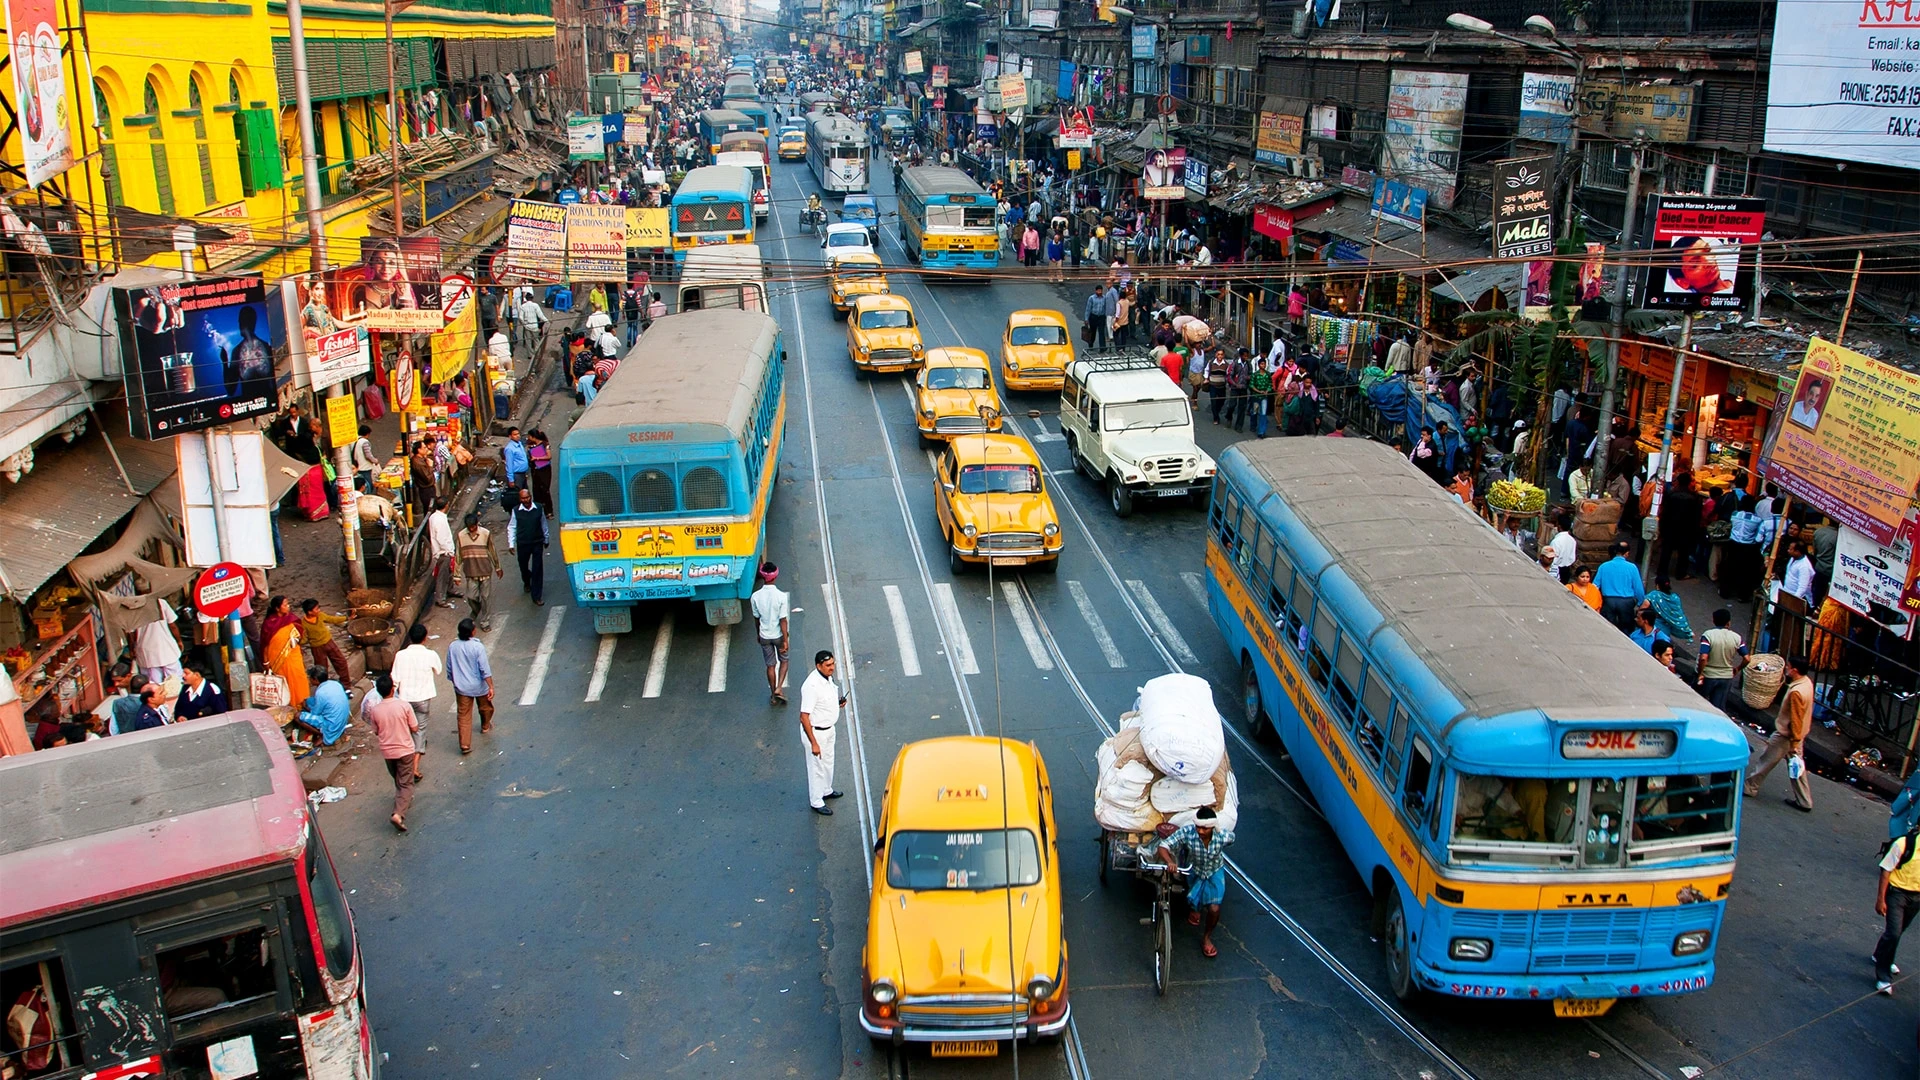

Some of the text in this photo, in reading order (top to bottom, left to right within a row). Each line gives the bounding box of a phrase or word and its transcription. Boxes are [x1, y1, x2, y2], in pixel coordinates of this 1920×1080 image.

[511, 201, 567, 224] ABHISHEK
[570, 206, 624, 218] ROYAL TOUCH
[1706, 203, 1727, 211] 24-year
[570, 218, 603, 227] CREATIONS
[1661, 213, 1682, 223] Died
[1698, 213, 1717, 224] Oral
[1718, 214, 1752, 225] Cancer
[1501, 219, 1549, 246] Mala
[1500, 243, 1549, 258] SAREES
[320, 331, 356, 359] Ashok
[232, 401, 267, 415] QUIT TODAY
[628, 431, 674, 443] RESHMA
[593, 528, 618, 542] STOP
[632, 563, 683, 583] DANGER
[688, 563, 729, 579] HORN
[210, 583, 224, 592] ENTRY
[225, 578, 241, 588] EXCEPT
[946, 789, 978, 798] TAXI
[946, 833, 983, 845] JAI MATA DI
[1565, 893, 1629, 903] TATA
[1451, 984, 1507, 998] SPEED
